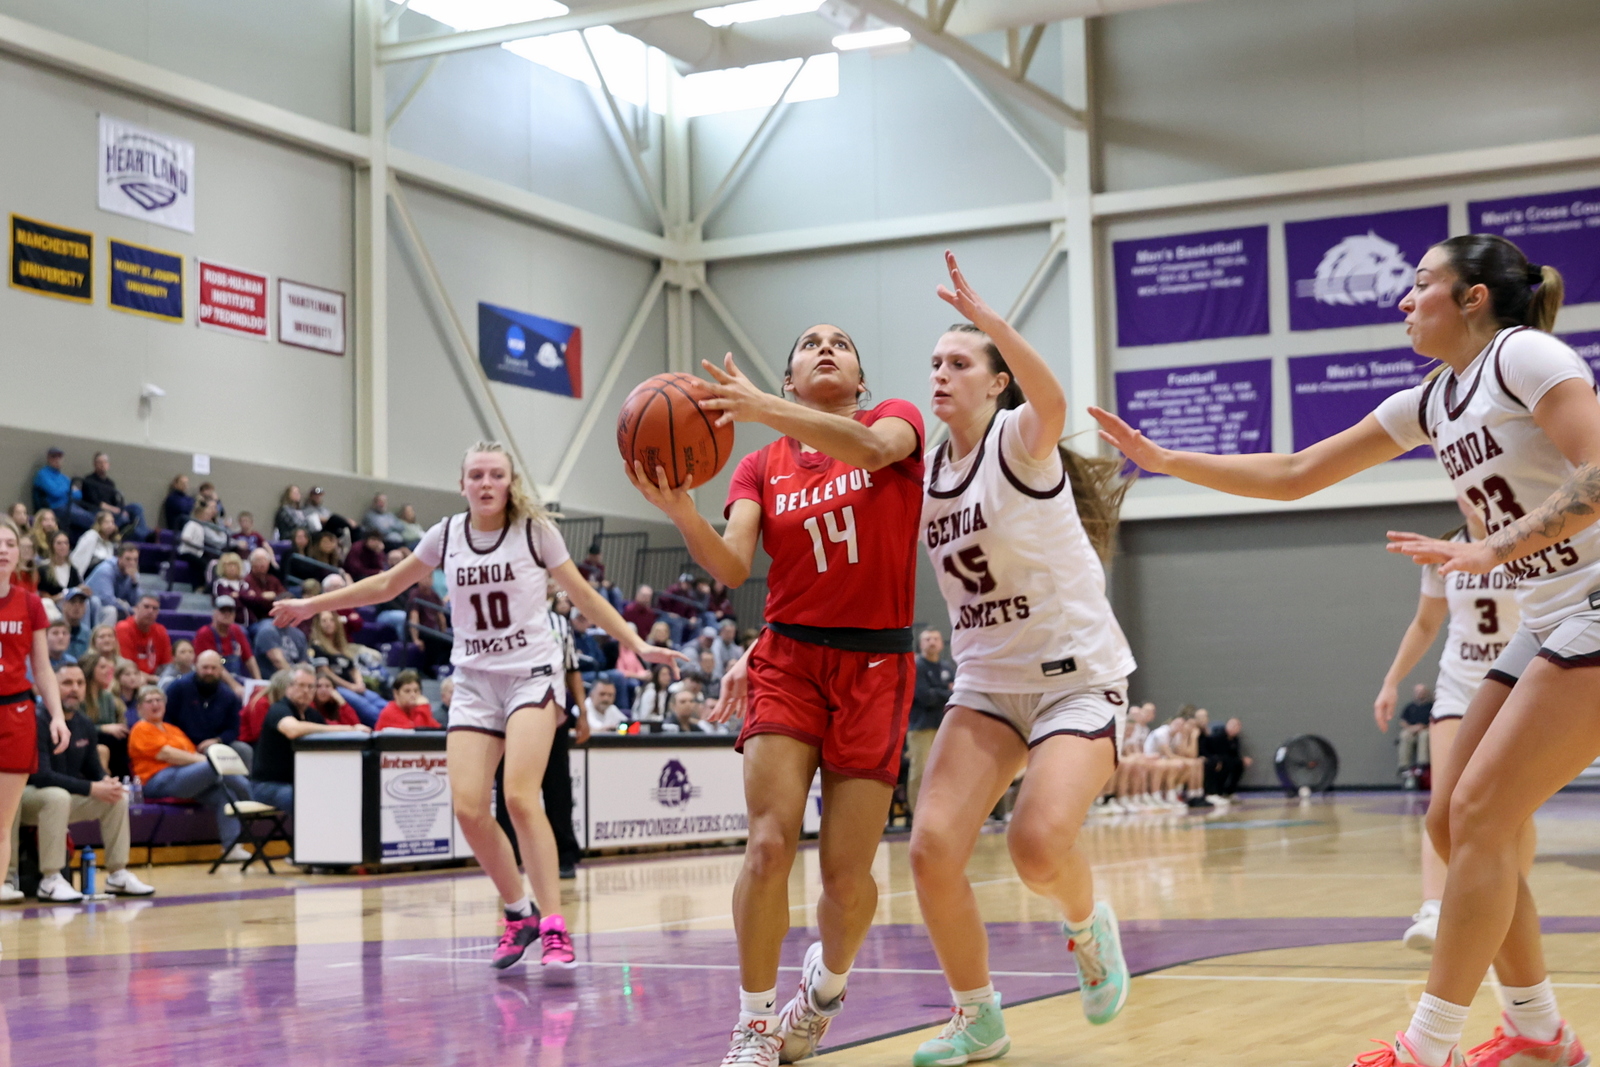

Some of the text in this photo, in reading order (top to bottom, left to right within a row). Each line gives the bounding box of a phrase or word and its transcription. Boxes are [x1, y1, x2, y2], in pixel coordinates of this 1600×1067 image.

[106, 144, 187, 195] HEARTLAND
[1481, 208, 1524, 227] Men's
[1525, 205, 1570, 221] Cross
[1570, 200, 1600, 217] Cou
[16, 227, 89, 260] MANCHESTER
[1136, 239, 1243, 264] Men's Basketball
[19, 260, 85, 288] UNIVERSITY
[115, 258, 140, 276] MOUNT
[153, 268, 180, 284] JOSEPH
[203, 267, 263, 295] ROSE-HULMAN
[126, 279, 168, 299] UNIVERSITY
[210, 288, 256, 312] INSTITUTE
[200, 303, 213, 319] OF
[294, 320, 332, 340] UNIVERSITY
[1167, 370, 1217, 386] Football
[1326, 360, 1415, 379] Men's Tennis
[1440, 425, 1504, 480] GENOA
[776, 468, 873, 516] BELLEVUE
[1464, 473, 1527, 537] 23
[803, 505, 859, 573] 14
[927, 502, 988, 549] GENOA
[942, 543, 997, 594] 15
[1503, 538, 1579, 582] METS
[456, 562, 516, 587] GENOA
[470, 591, 511, 631] 10
[954, 595, 1030, 631] OMETS
[1475, 598, 1498, 634] 3
[0, 620, 23, 635] VUE
[465, 629, 528, 657] COMETS
[1103, 690, 1124, 706] C
